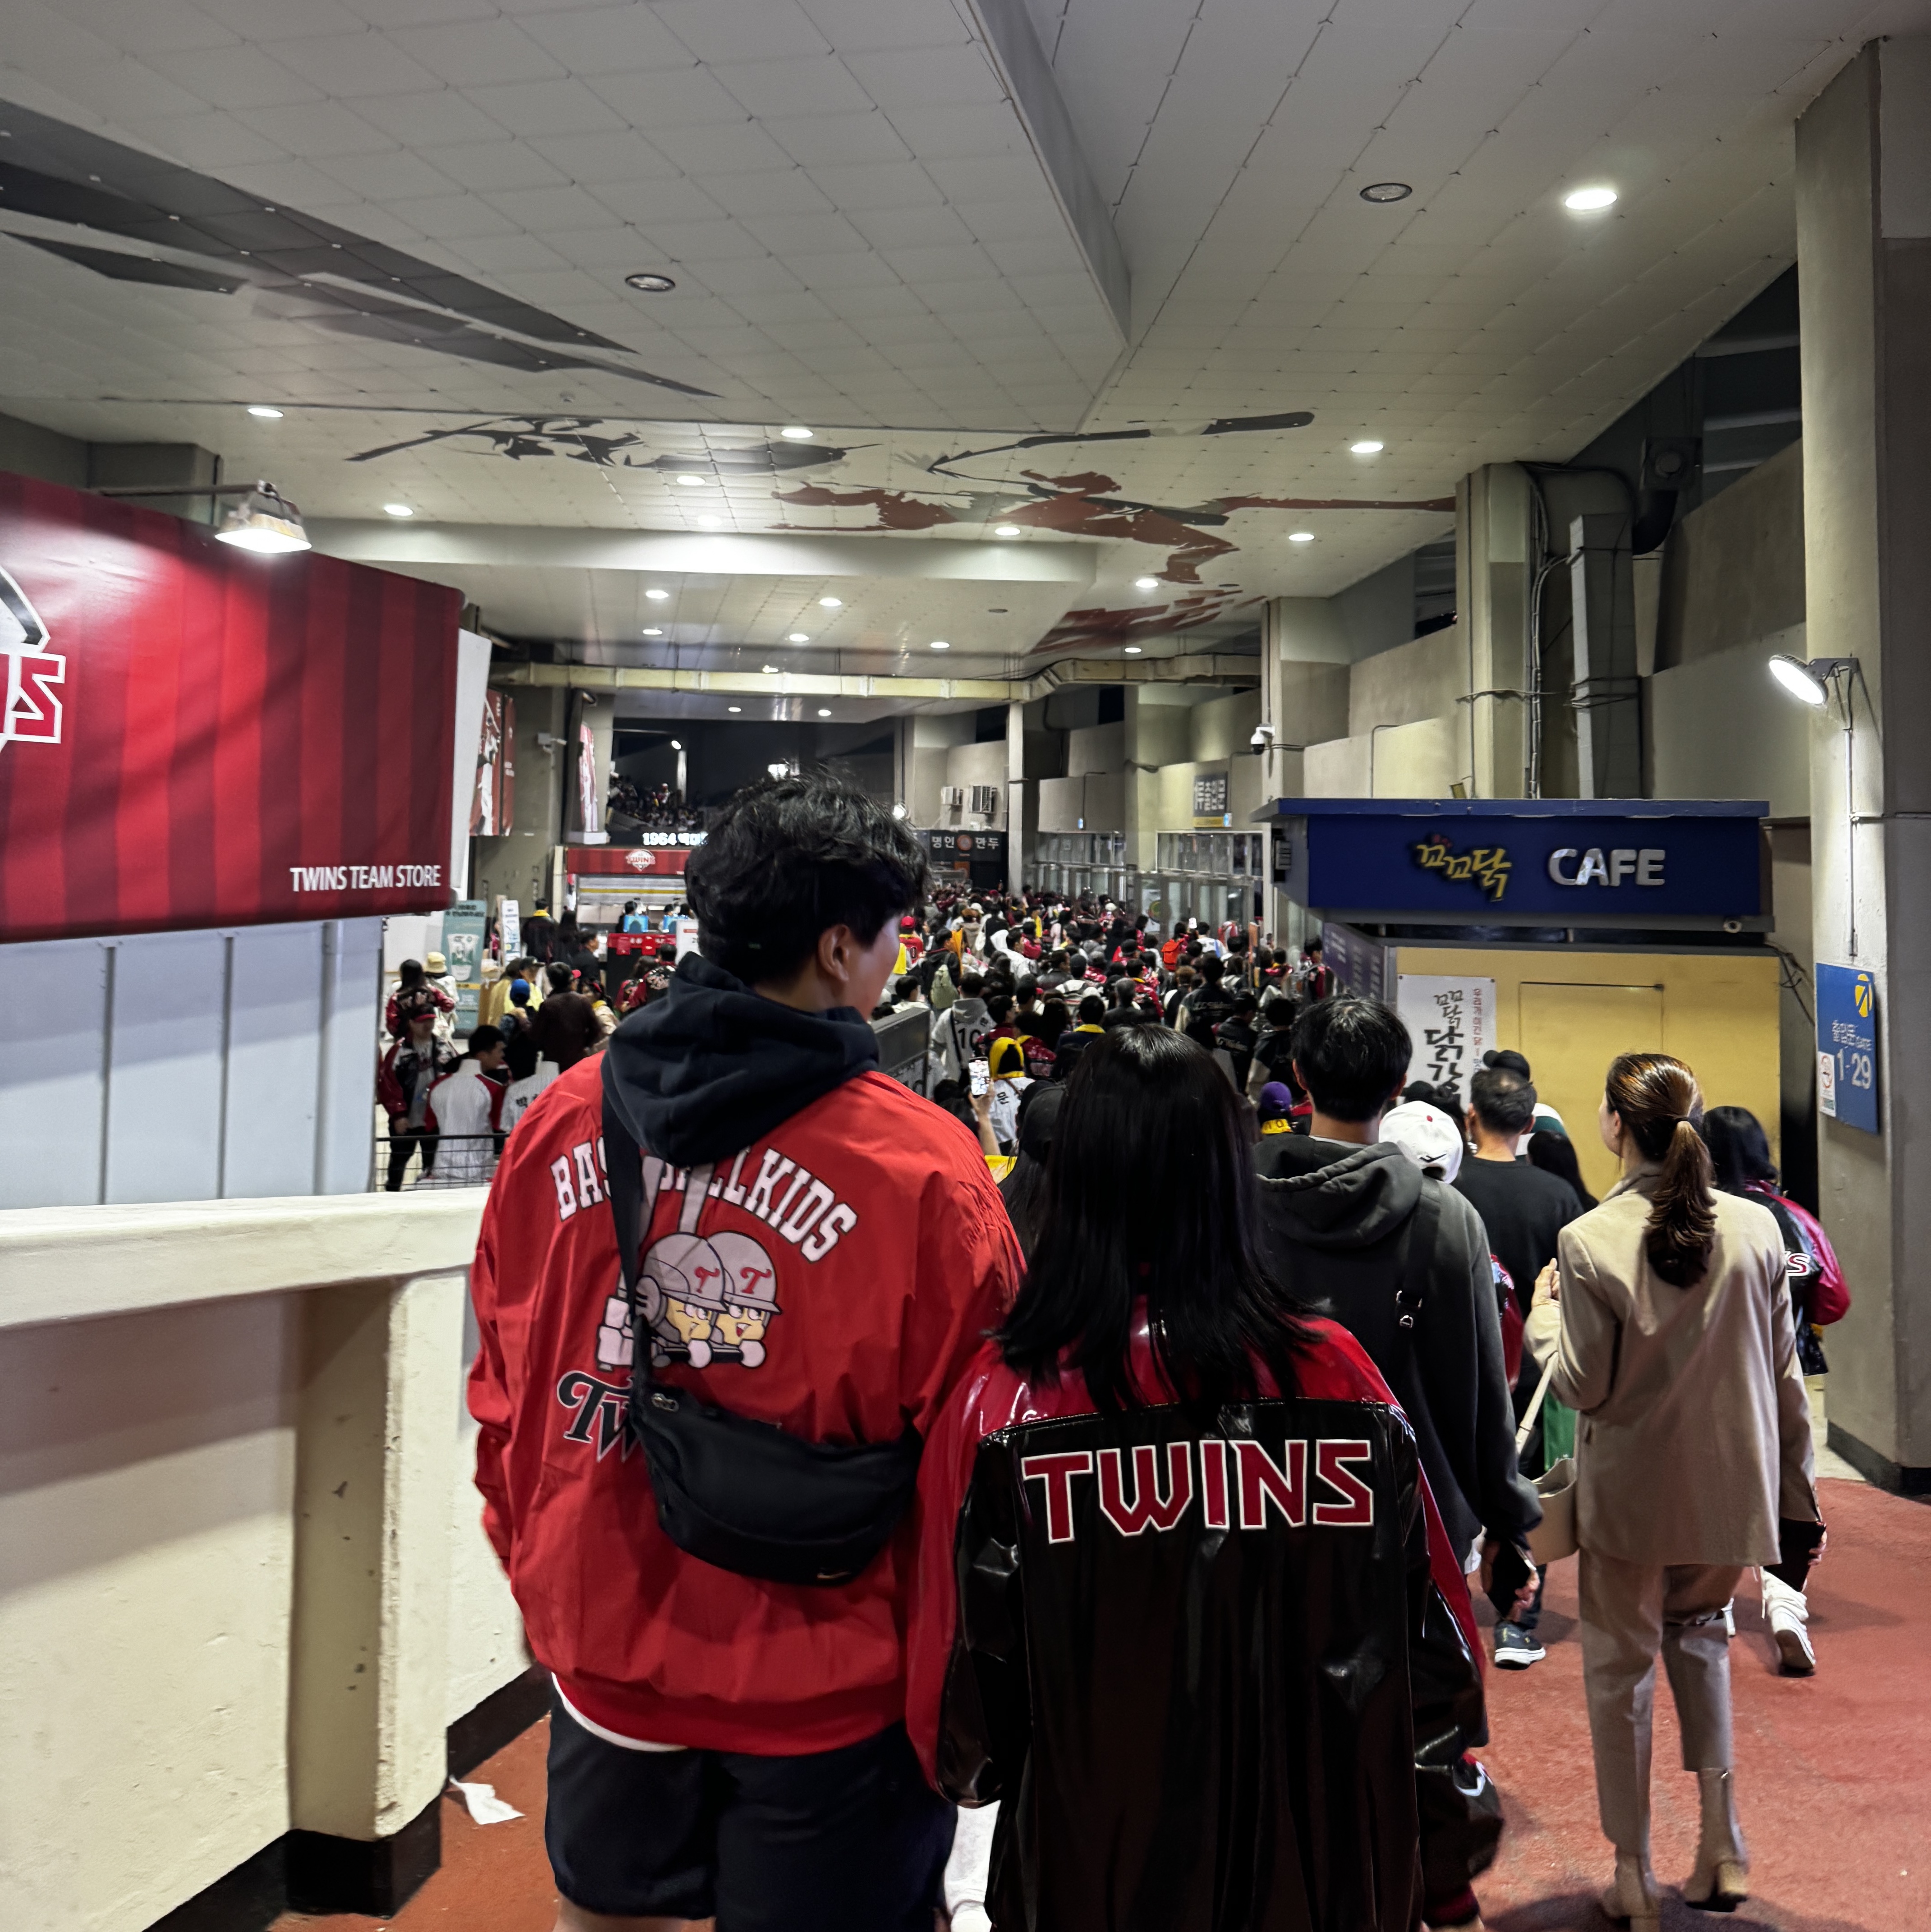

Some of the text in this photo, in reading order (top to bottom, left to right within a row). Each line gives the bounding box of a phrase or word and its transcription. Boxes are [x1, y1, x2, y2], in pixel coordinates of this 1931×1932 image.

[931, 836, 999, 849] 명인 만두
[289, 865, 442, 892] TWINS TEAM STORE
[1547, 847, 1666, 887] CAFE
[1424, 1026, 1464, 1099] 닭강
[1836, 1048, 1871, 1090] 1-29
[1021, 1439, 1373, 1544] TWINS
